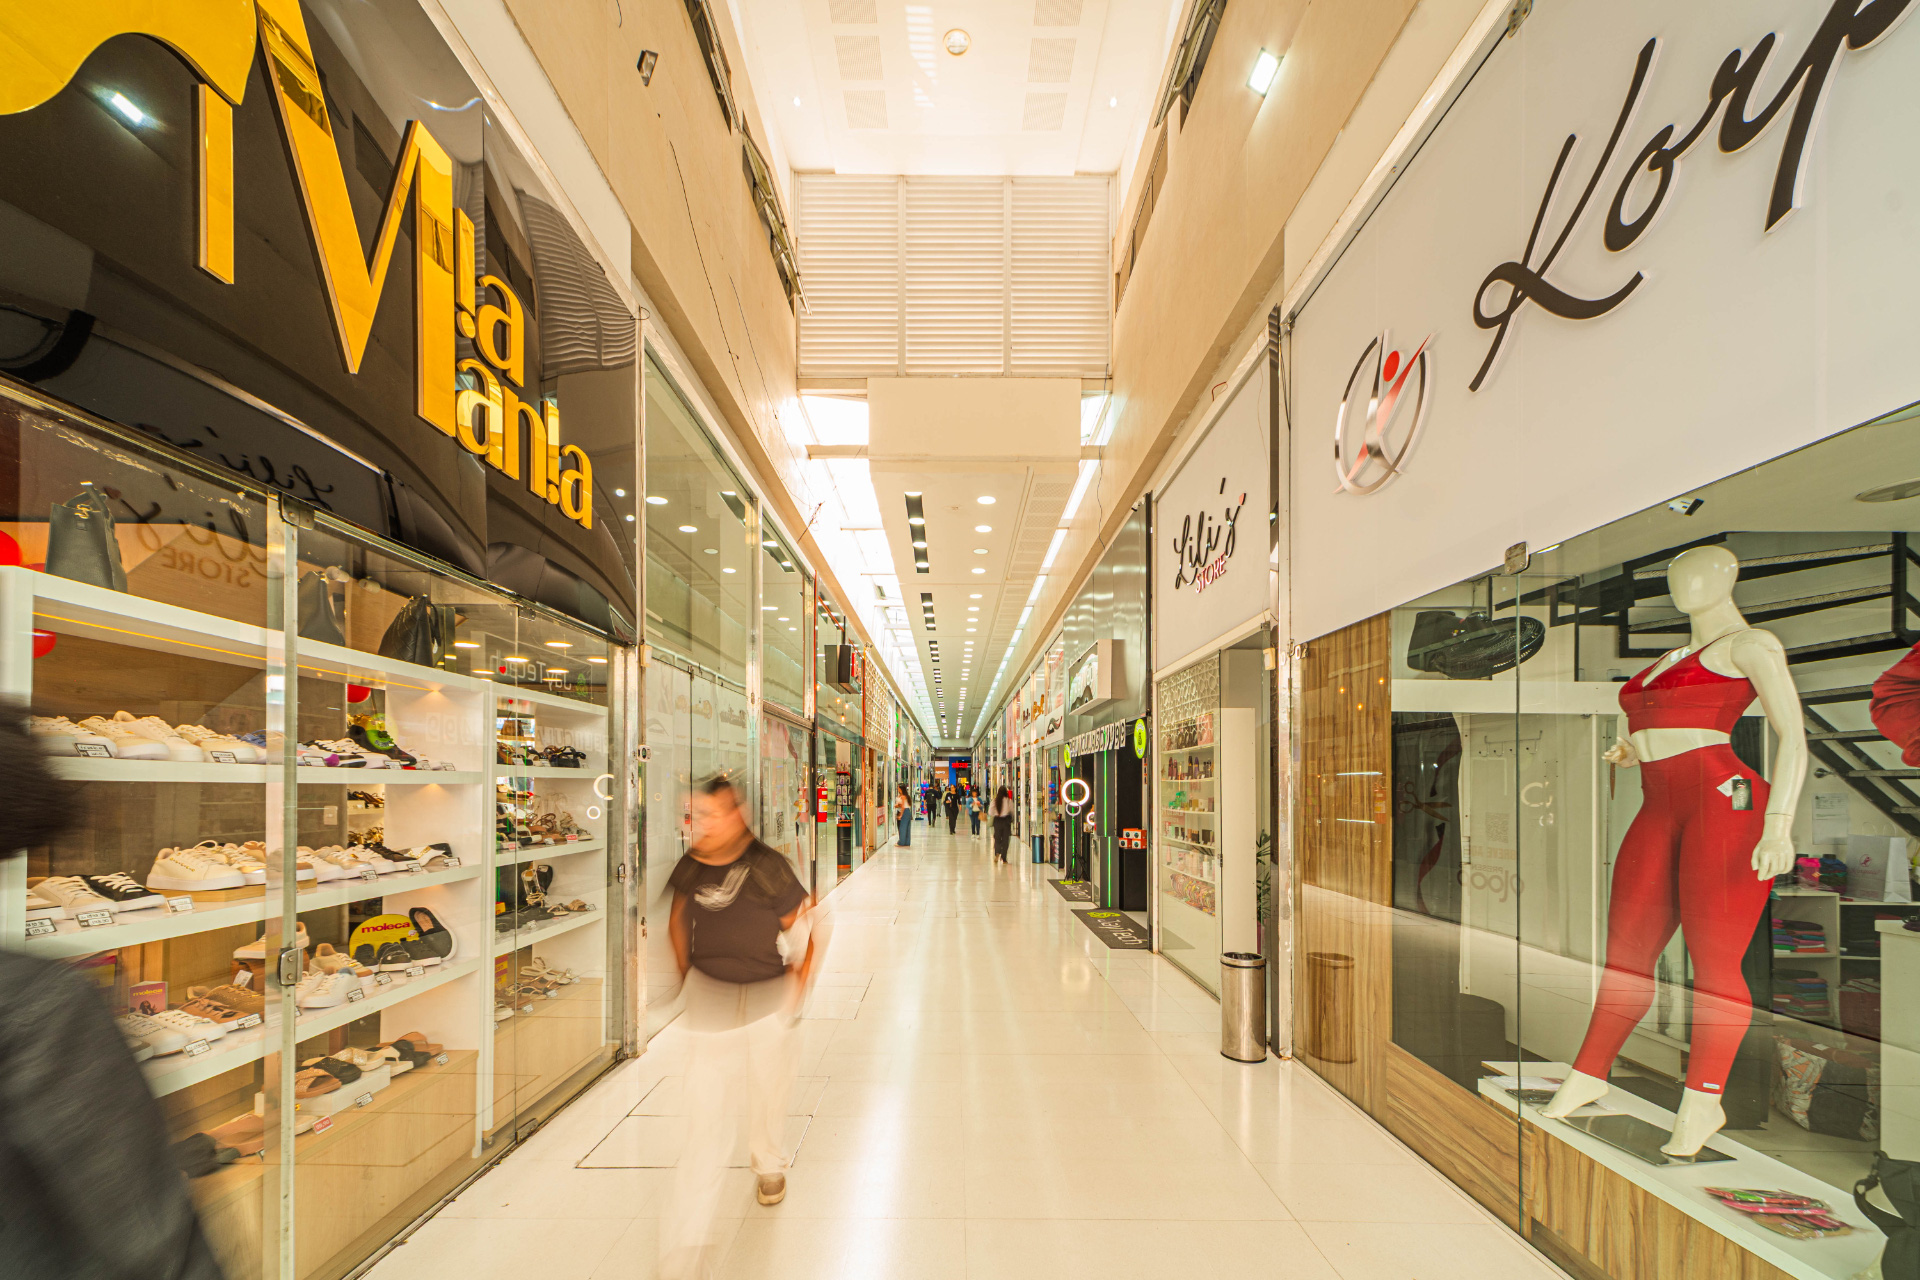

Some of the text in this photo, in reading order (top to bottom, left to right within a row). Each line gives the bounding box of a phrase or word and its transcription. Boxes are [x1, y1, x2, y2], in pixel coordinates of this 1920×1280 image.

[1173, 477, 1247, 590] Lili's
[1195, 551, 1227, 594] STORE
[361, 921, 411, 934] moleca
